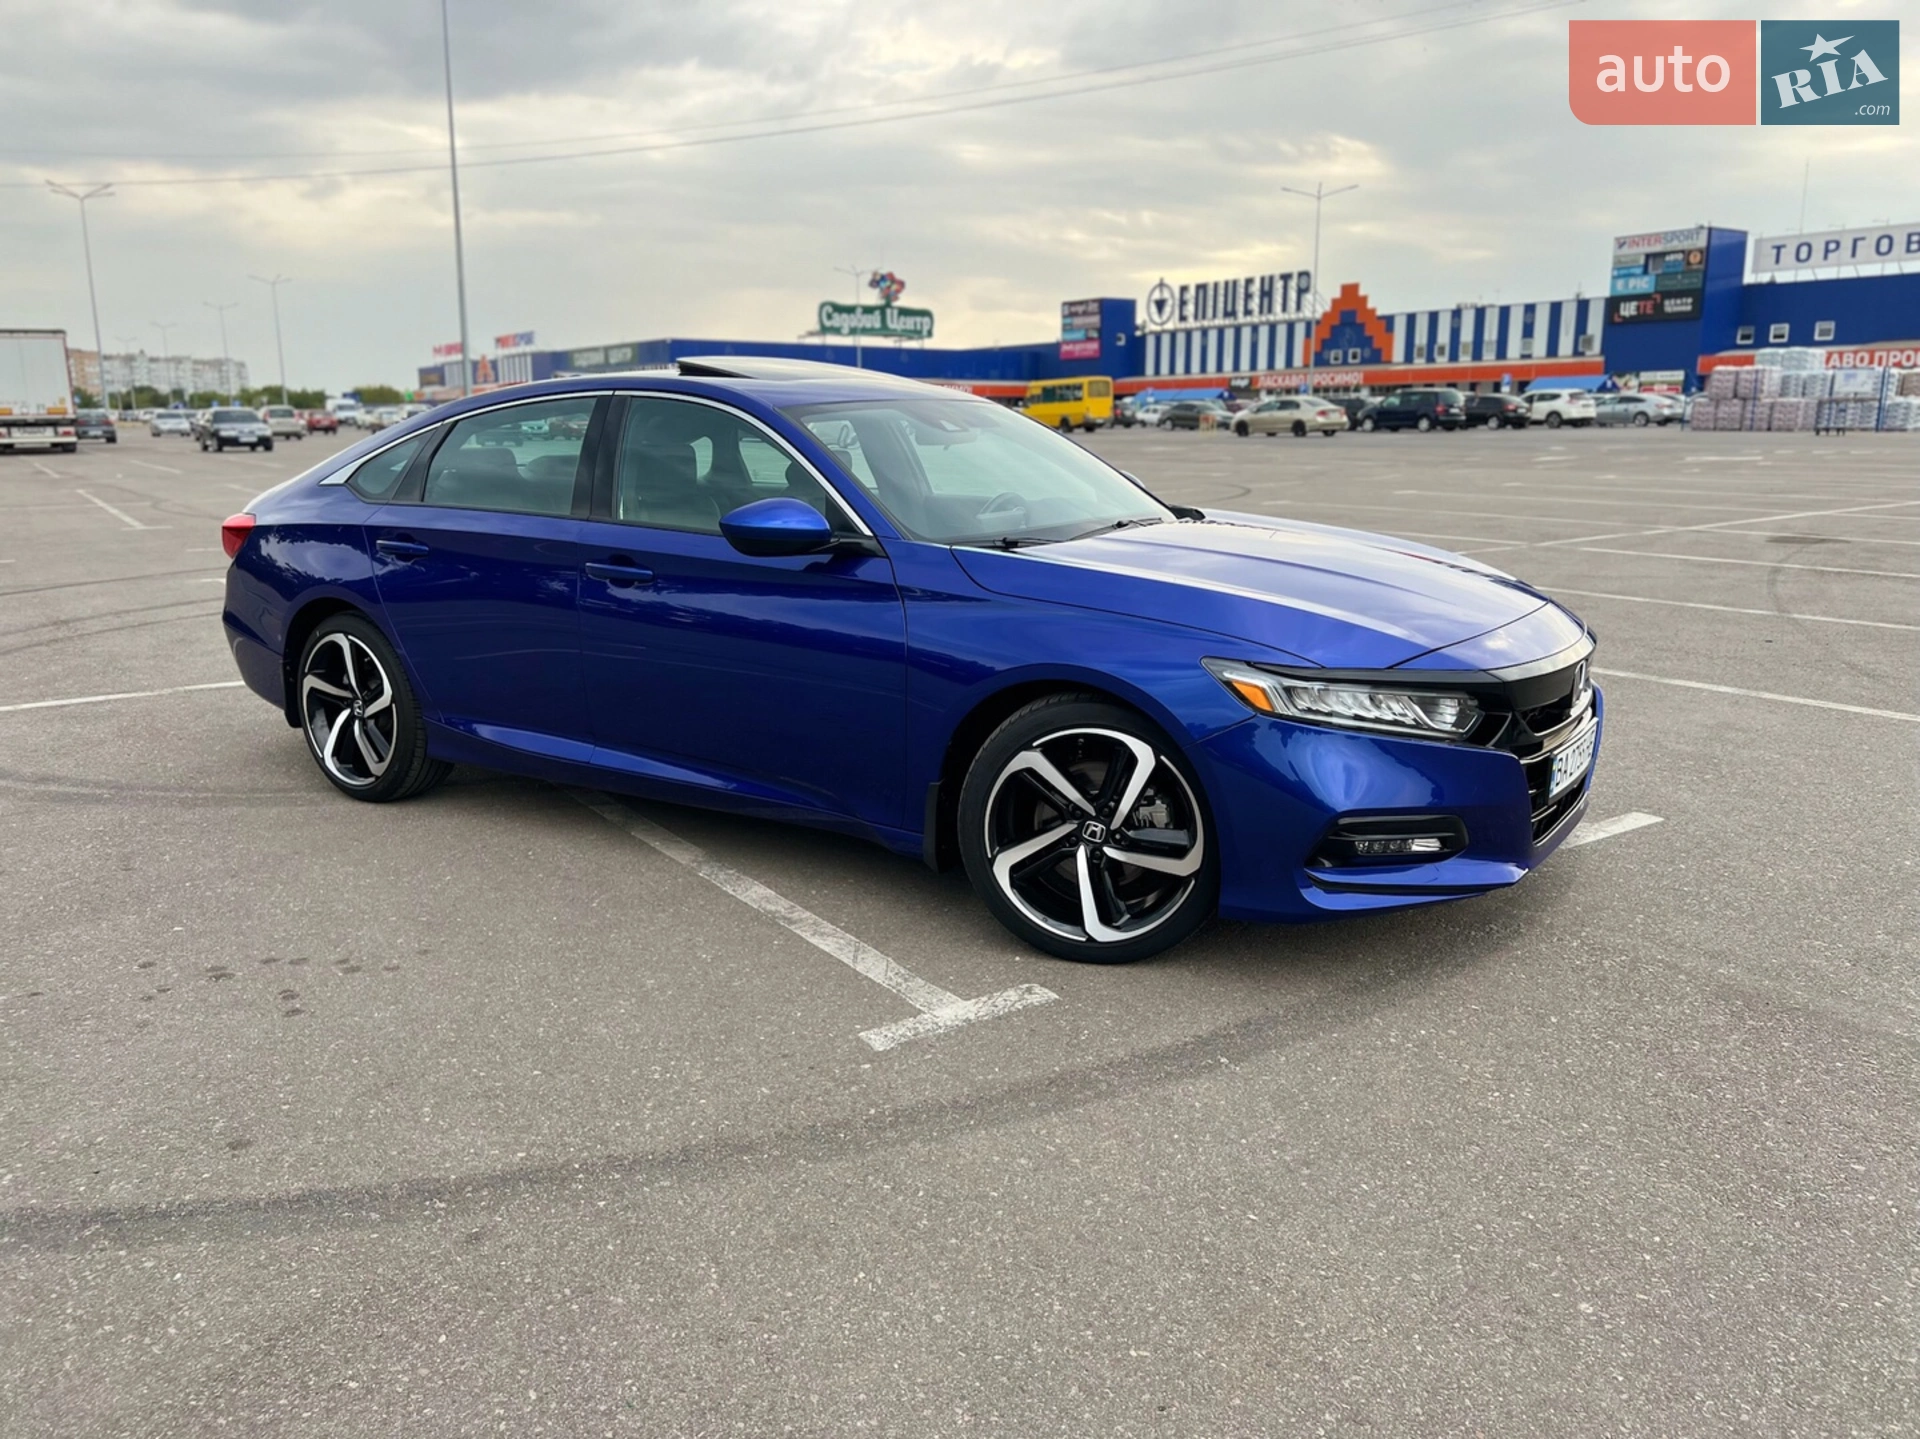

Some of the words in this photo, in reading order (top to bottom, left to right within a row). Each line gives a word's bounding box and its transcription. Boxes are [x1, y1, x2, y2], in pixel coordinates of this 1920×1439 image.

[1627, 230, 1701, 249] INTERSPORT
[1771, 231, 1920, 265] ТОРГОВ
[1178, 270, 1312, 323] ЕПІЦЕНТР
[1825, 351, 1870, 369] АВО
